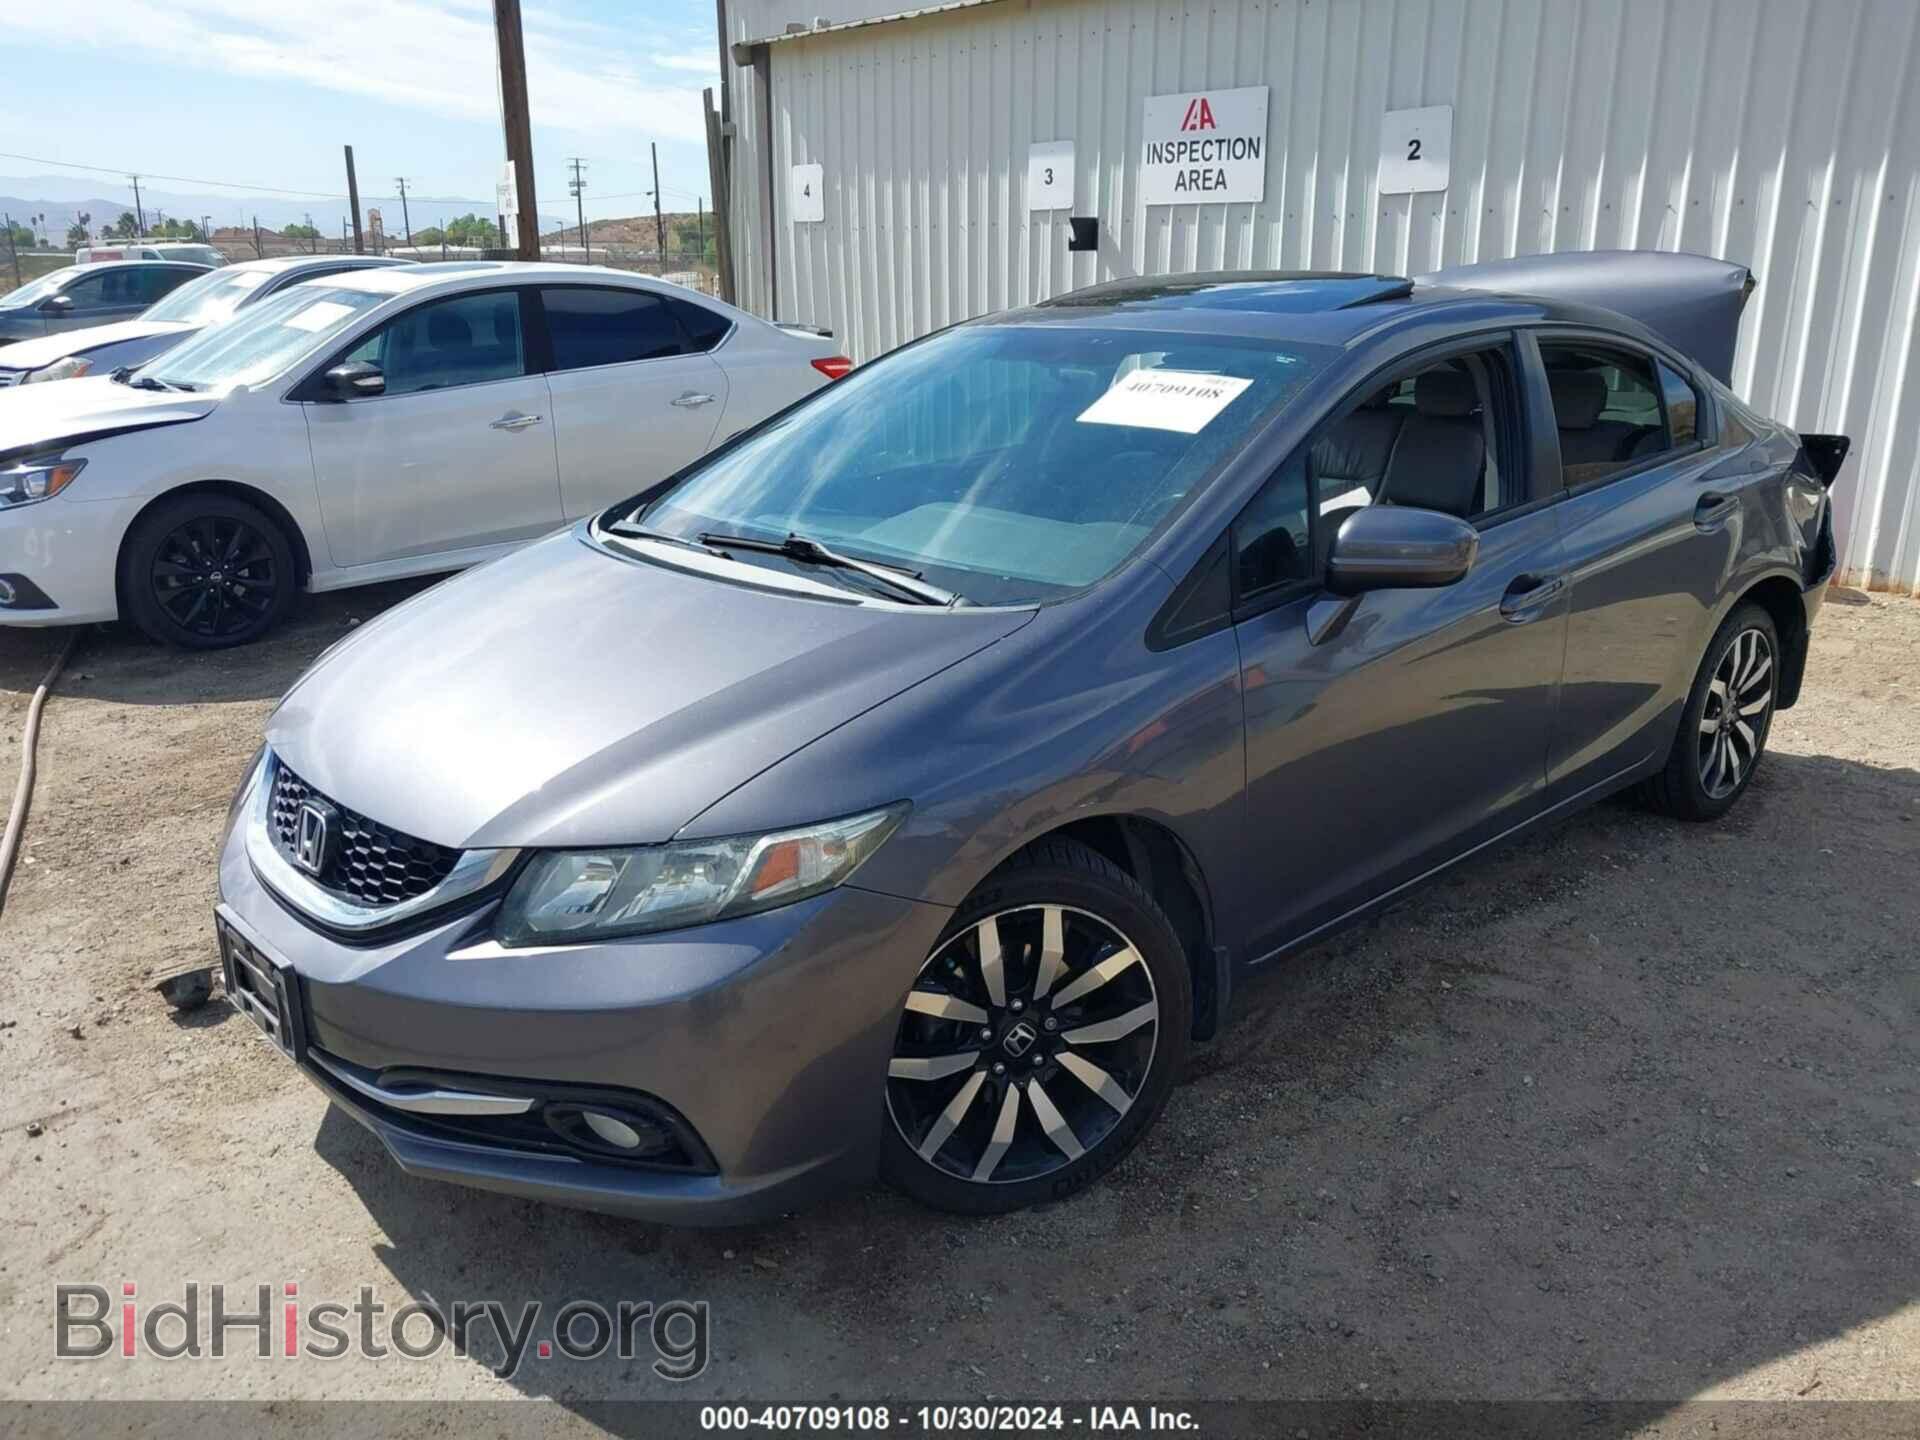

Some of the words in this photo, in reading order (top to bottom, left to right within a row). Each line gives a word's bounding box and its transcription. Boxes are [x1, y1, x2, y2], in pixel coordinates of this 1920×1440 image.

[1146, 136, 1261, 165] INSPECTION
[1407, 139, 1421, 161] 2
[1044, 168, 1053, 185] 3
[1174, 168, 1227, 191] AREA
[803, 183, 810, 198] 4
